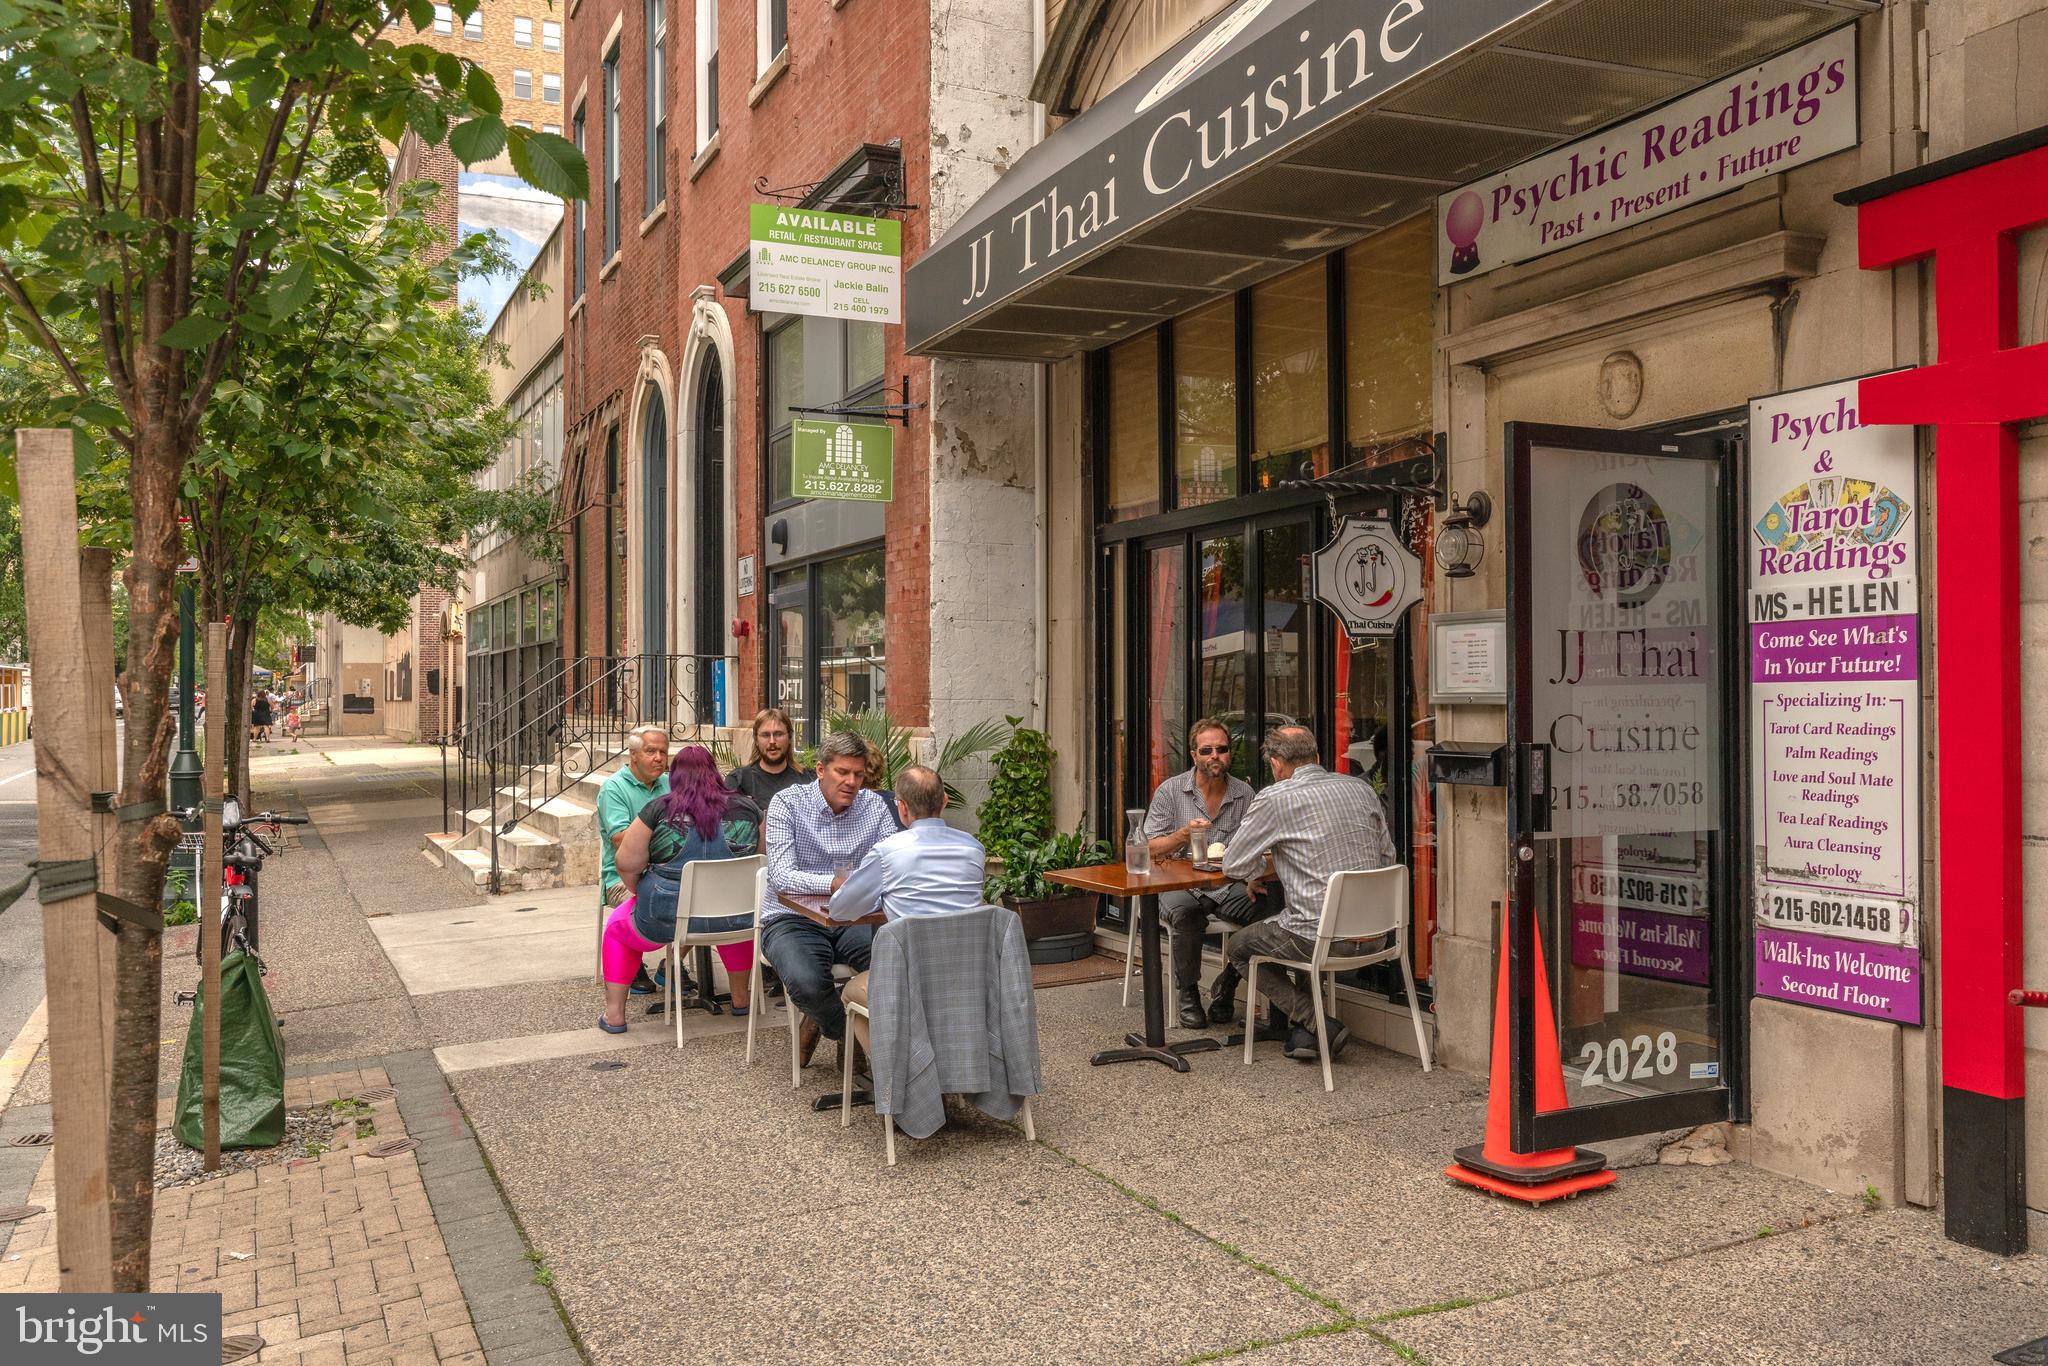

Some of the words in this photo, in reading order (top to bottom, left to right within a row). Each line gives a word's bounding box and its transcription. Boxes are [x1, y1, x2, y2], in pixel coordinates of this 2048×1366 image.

[962, 230, 994, 305] JJ
[1011, 153, 1120, 275] Thai
[1142, 0, 1425, 195] Cuisine
[1490, 145, 1629, 227] Psychic
[1641, 57, 1846, 170] Readings
[1540, 210, 1585, 245] Past
[1610, 172, 1692, 222] Present
[1717, 134, 1802, 183] Future
[776, 212, 876, 236] AVAILABLE
[769, 229, 797, 241] RETAIL
[804, 233, 856, 248] RESTAURANT
[857, 240, 883, 251] SPACE
[779, 254, 799, 264] AMC
[800, 256, 845, 268] DELANCEY
[847, 261, 877, 272] GROUP
[879, 265, 895, 274] INC.
[759, 282, 776, 293] 215
[778, 284, 796, 295] 627
[798, 286, 821, 297] 6500
[833, 280, 863, 291] Jackie
[833, 303, 849, 311] 215
[851, 305, 867, 313] 400
[869, 306, 889, 315] 1979
[797, 426, 819, 434] Managed
[1770, 397, 1870, 450] Psych
[819, 462, 835, 470] AMC
[1813, 449, 1834, 474] &
[804, 480, 882, 494] 215.627.8282
[810, 490, 877, 499] amcdmanagement.com
[1787, 495, 1874, 534] Tarot
[1759, 537, 1907, 580] Readings
[1348, 620, 1367, 629] Thai
[1367, 621, 1394, 629] Cuisine
[1759, 631, 1804, 649] Come
[1808, 628, 1837, 647] See
[1842, 624, 1908, 646] What's
[1549, 629, 1588, 684] JJ
[1764, 658, 1782, 675] In
[1784, 656, 1826, 675] Your
[1830, 654, 1902, 675] Future!
[1776, 693, 1862, 712] Specializing
[1865, 693, 1887, 707] In:
[1769, 721, 1800, 735] Tarot
[1803, 722, 1833, 736] Card
[1836, 723, 1897, 741] Readings
[1784, 746, 1816, 760] Palm
[1819, 747, 1879, 766] Readings
[1772, 770, 1799, 784] Love
[1801, 770, 1825, 785] and
[1828, 771, 1857, 786] Soul
[1859, 773, 1894, 788] Mate
[1801, 788, 1860, 809] Readings
[1776, 811, 1798, 825] Tea
[1800, 812, 1826, 827] Leaf
[1828, 814, 1889, 836] Readings
[1783, 835, 1814, 851] Aura
[1817, 837, 1882, 861] Cleansing
[1803, 861, 1863, 884] Astrology
[1773, 896, 1891, 933] 215-602-1458
[1762, 939, 1831, 971] Walk-Ins
[1834, 951, 1912, 984] Welcome
[1781, 975, 1839, 1001] Second
[1843, 986, 1890, 1010] Floor
[1580, 1031, 1678, 1088] 2028
